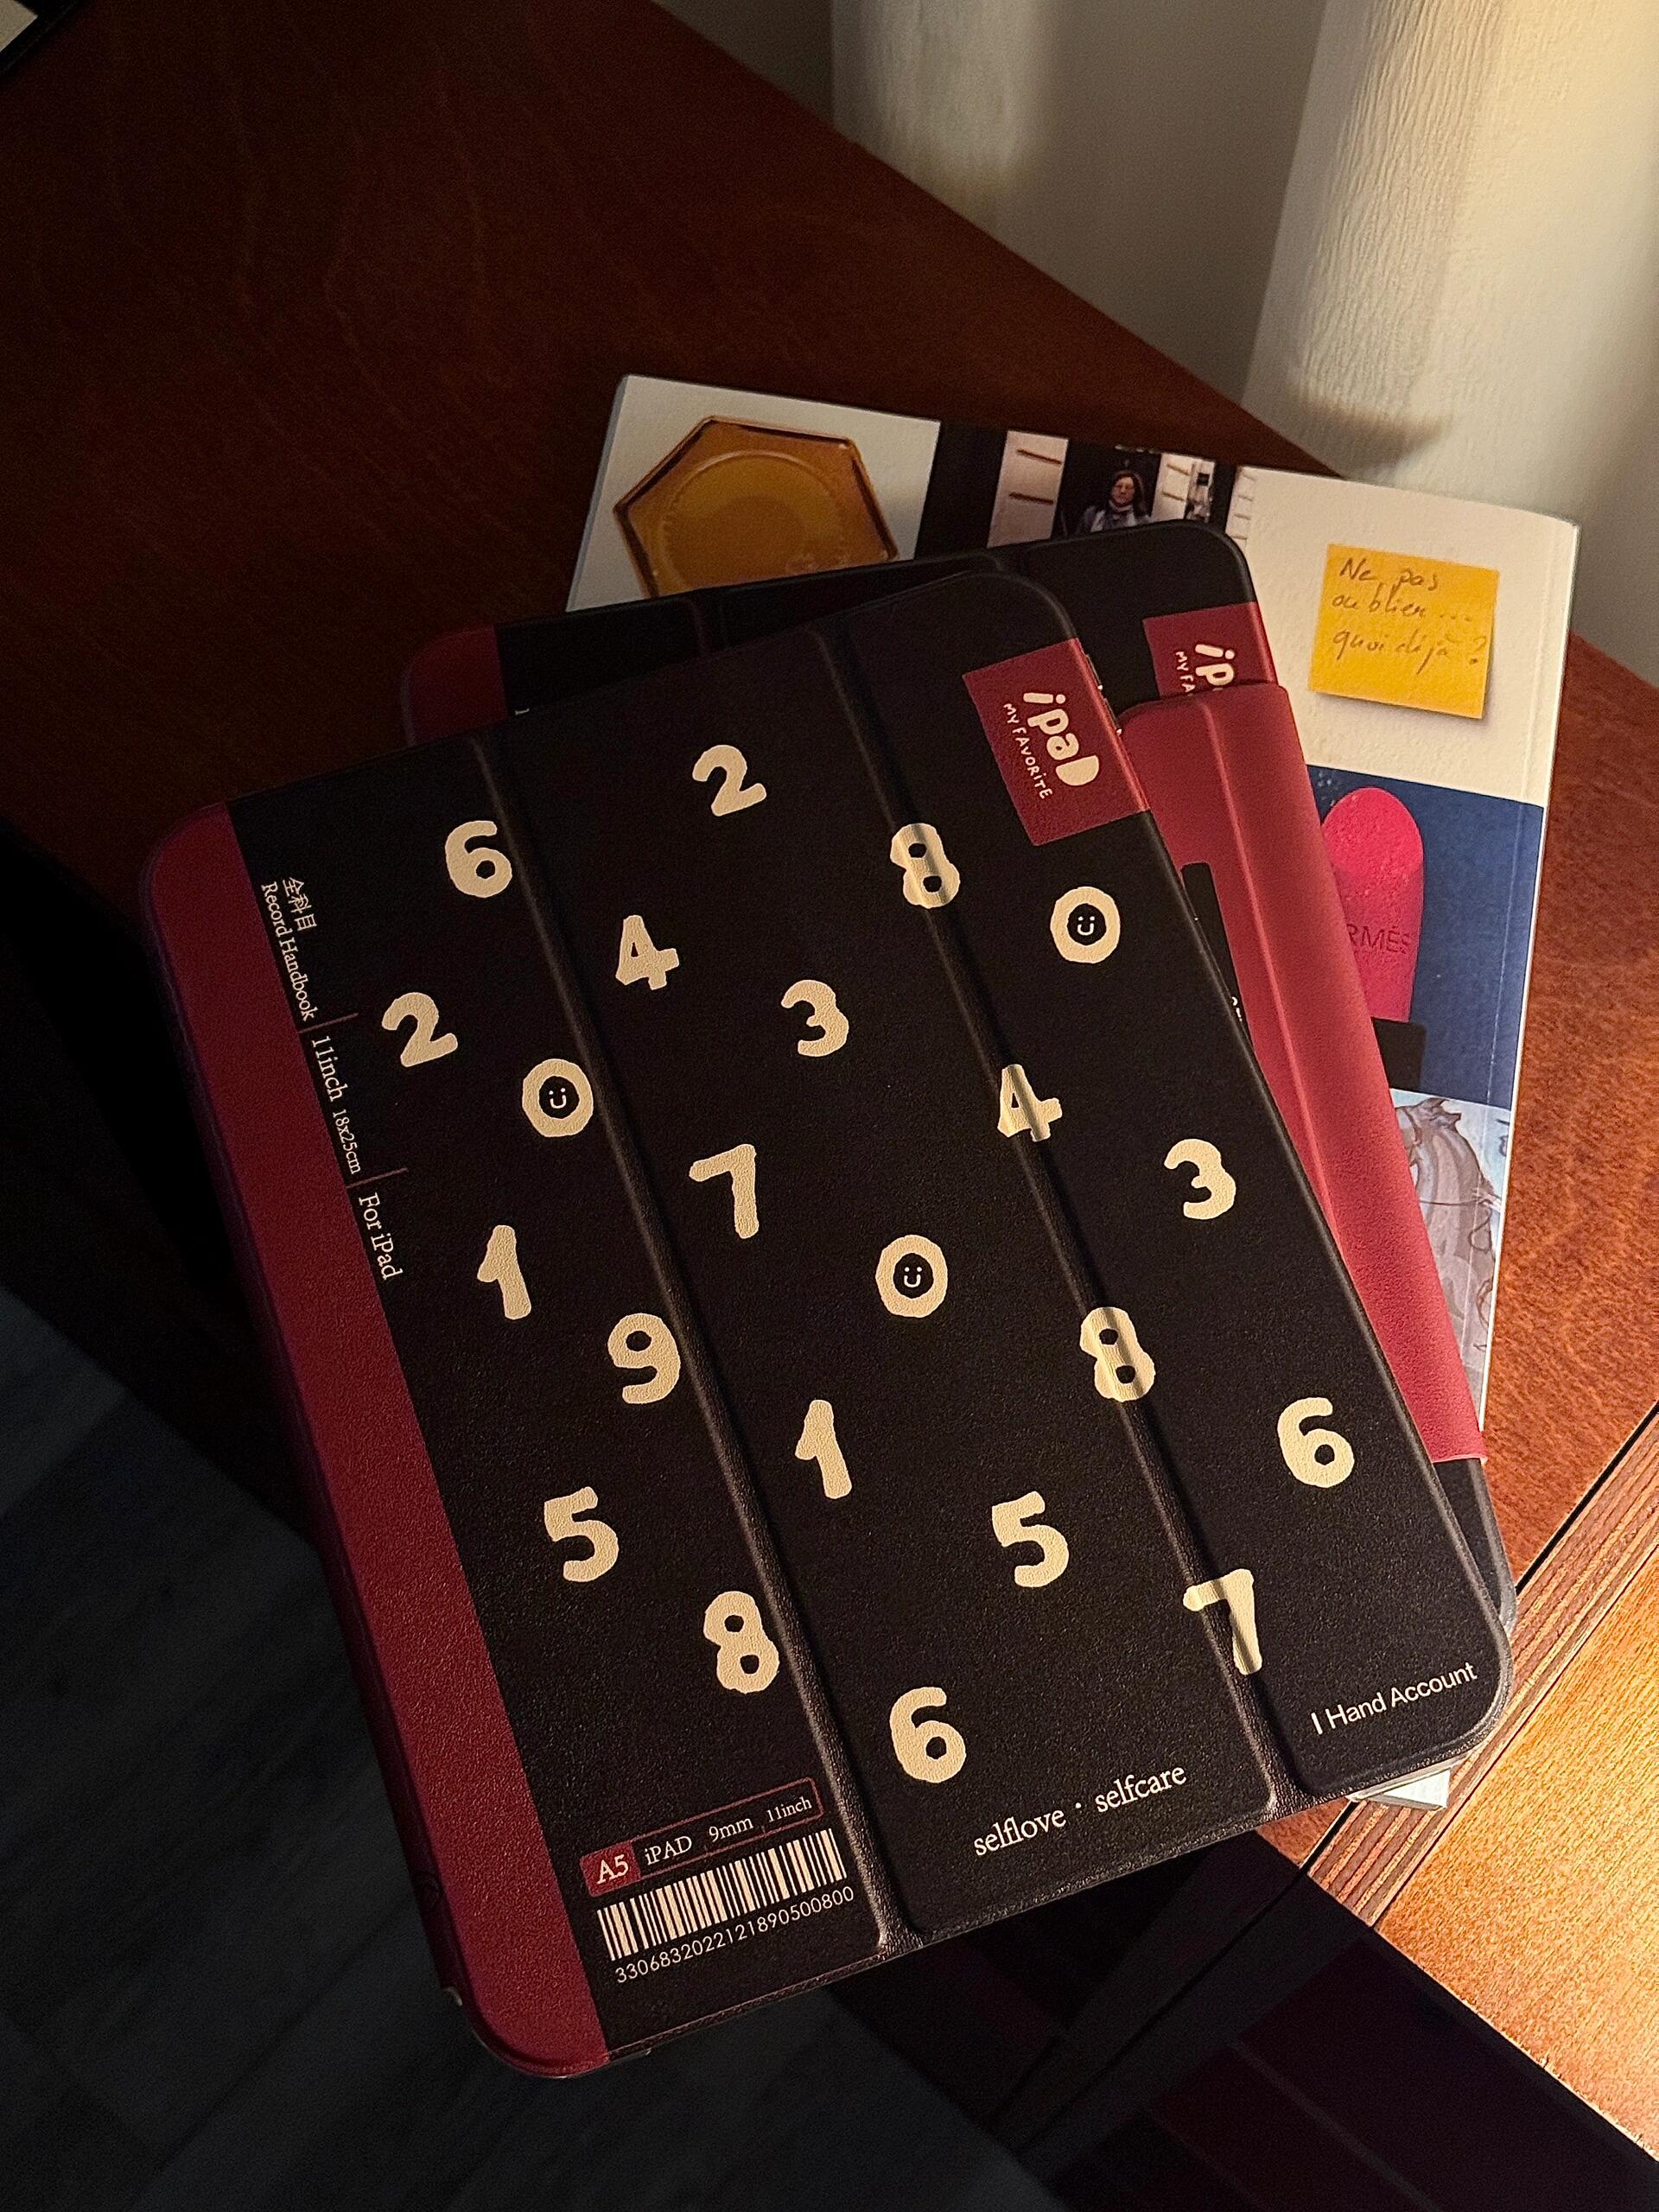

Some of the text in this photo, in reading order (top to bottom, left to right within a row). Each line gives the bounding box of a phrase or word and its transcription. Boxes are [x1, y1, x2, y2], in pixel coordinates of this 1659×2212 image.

[1339, 557, 1439, 591] Ne pas
[1332, 628, 1389, 660] quoi
[1002, 702, 1020, 724] MY
[692, 745, 766, 817] 2
[282, 876, 317, 931] 全科目
[445, 821, 512, 898] 6
[890, 823, 960, 909] 8
[261, 881, 319, 1021] Record Handbook
[615, 915, 679, 990] 4
[1346, 923, 1412, 954] RMÈS
[382, 992, 458, 1067] 2
[781, 980, 849, 1057] 3
[311, 1035, 361, 1175] 11inch 18x25cm
[997, 1064, 1062, 1141] 4
[689, 1144, 759, 1239] 7
[1164, 1139, 1236, 1219] 3
[358, 1192, 403, 1281] For iPad
[477, 1225, 531, 1319] 1
[607, 1313, 681, 1404] 9
[1079, 1306, 1156, 1409] 8
[795, 1398, 852, 1499] 1
[1277, 1397, 1355, 1488] 6
[543, 1486, 619, 1582] 5
[992, 1491, 1069, 1592] 5
[703, 1591, 779, 1694] 8
[1183, 1568, 1262, 1675] 7
[889, 1687, 966, 1783] 6
[1325, 1692, 1387, 1729] Hand
[1390, 1662, 1478, 1709] Account
[596, 1796, 813, 1885] A5 iPAD 9mm 11inch
[973, 1764, 1187, 1857] selflove selfcare
[614, 1885, 855, 1984] 3306832022121890500800
